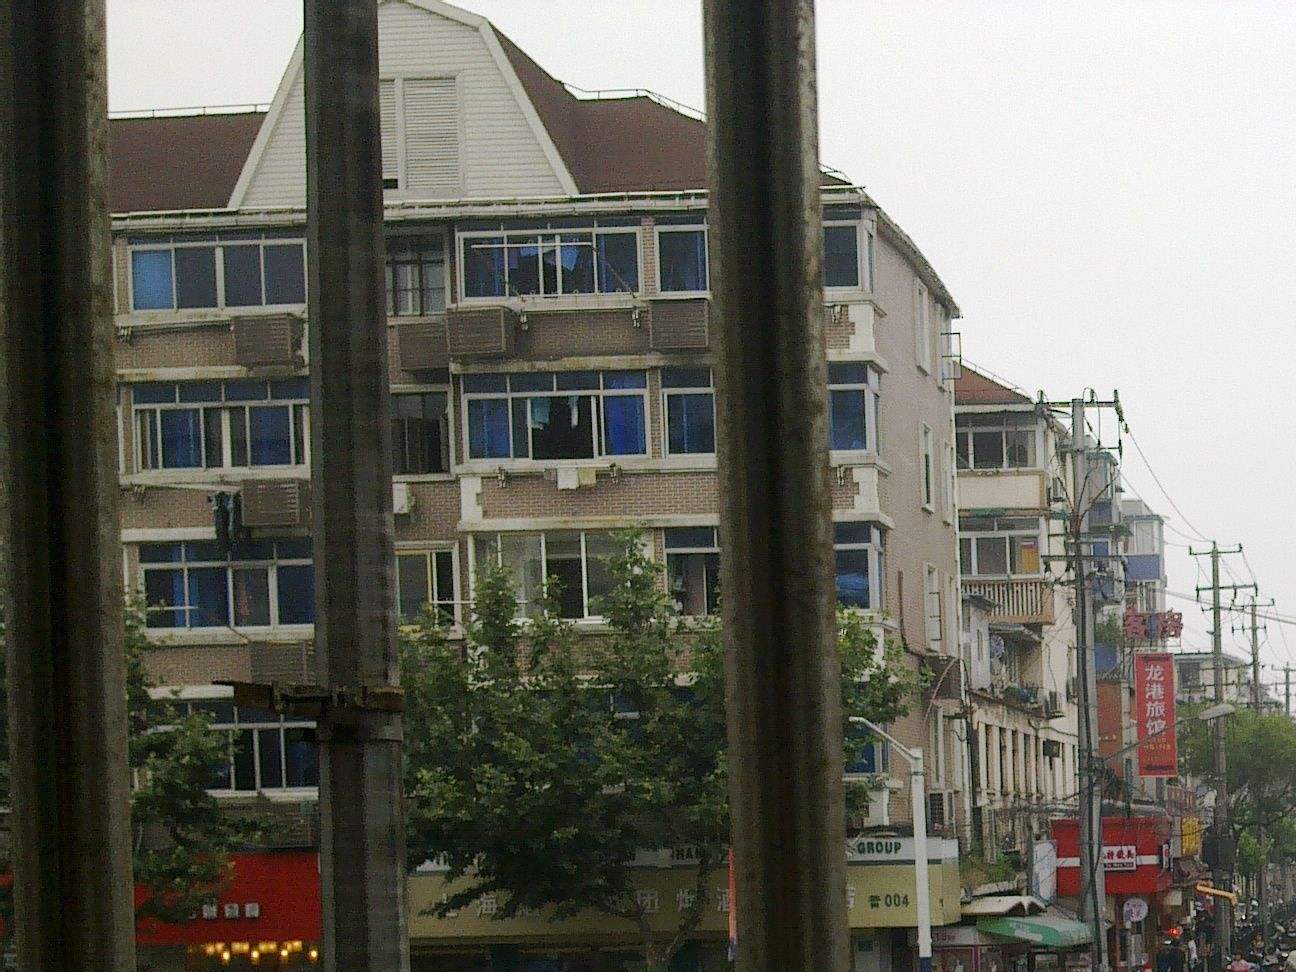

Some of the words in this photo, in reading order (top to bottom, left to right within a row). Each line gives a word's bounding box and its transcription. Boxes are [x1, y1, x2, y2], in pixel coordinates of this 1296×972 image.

[1144, 664, 1167, 736] 龙港旅馆
[857, 841, 902, 854] GROUP
